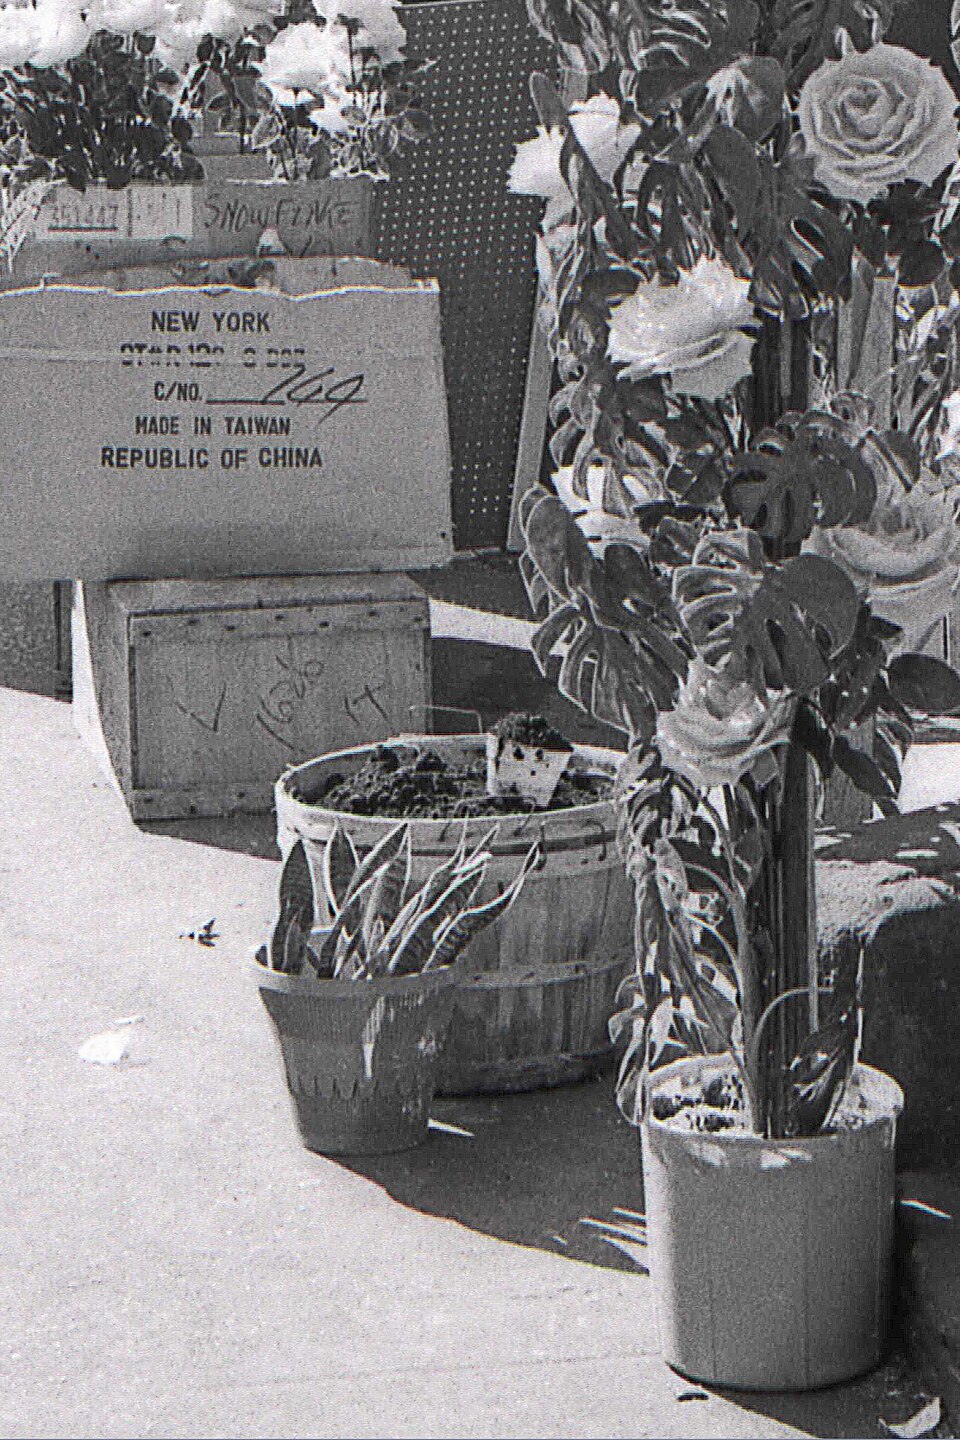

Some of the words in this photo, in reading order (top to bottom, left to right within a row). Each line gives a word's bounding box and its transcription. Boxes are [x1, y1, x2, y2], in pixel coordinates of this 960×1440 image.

[151, 311, 200, 332] NEW
[213, 311, 271, 333] YORK
[154, 380, 202, 402] C/NO.
[135, 416, 179, 435] MADE
[194, 416, 212, 435] IN
[224, 416, 291, 436] TAIWAN
[101, 446, 209, 469] REPUBLIC
[220, 447, 248, 469] OF
[258, 447, 323, 468] CHINA
